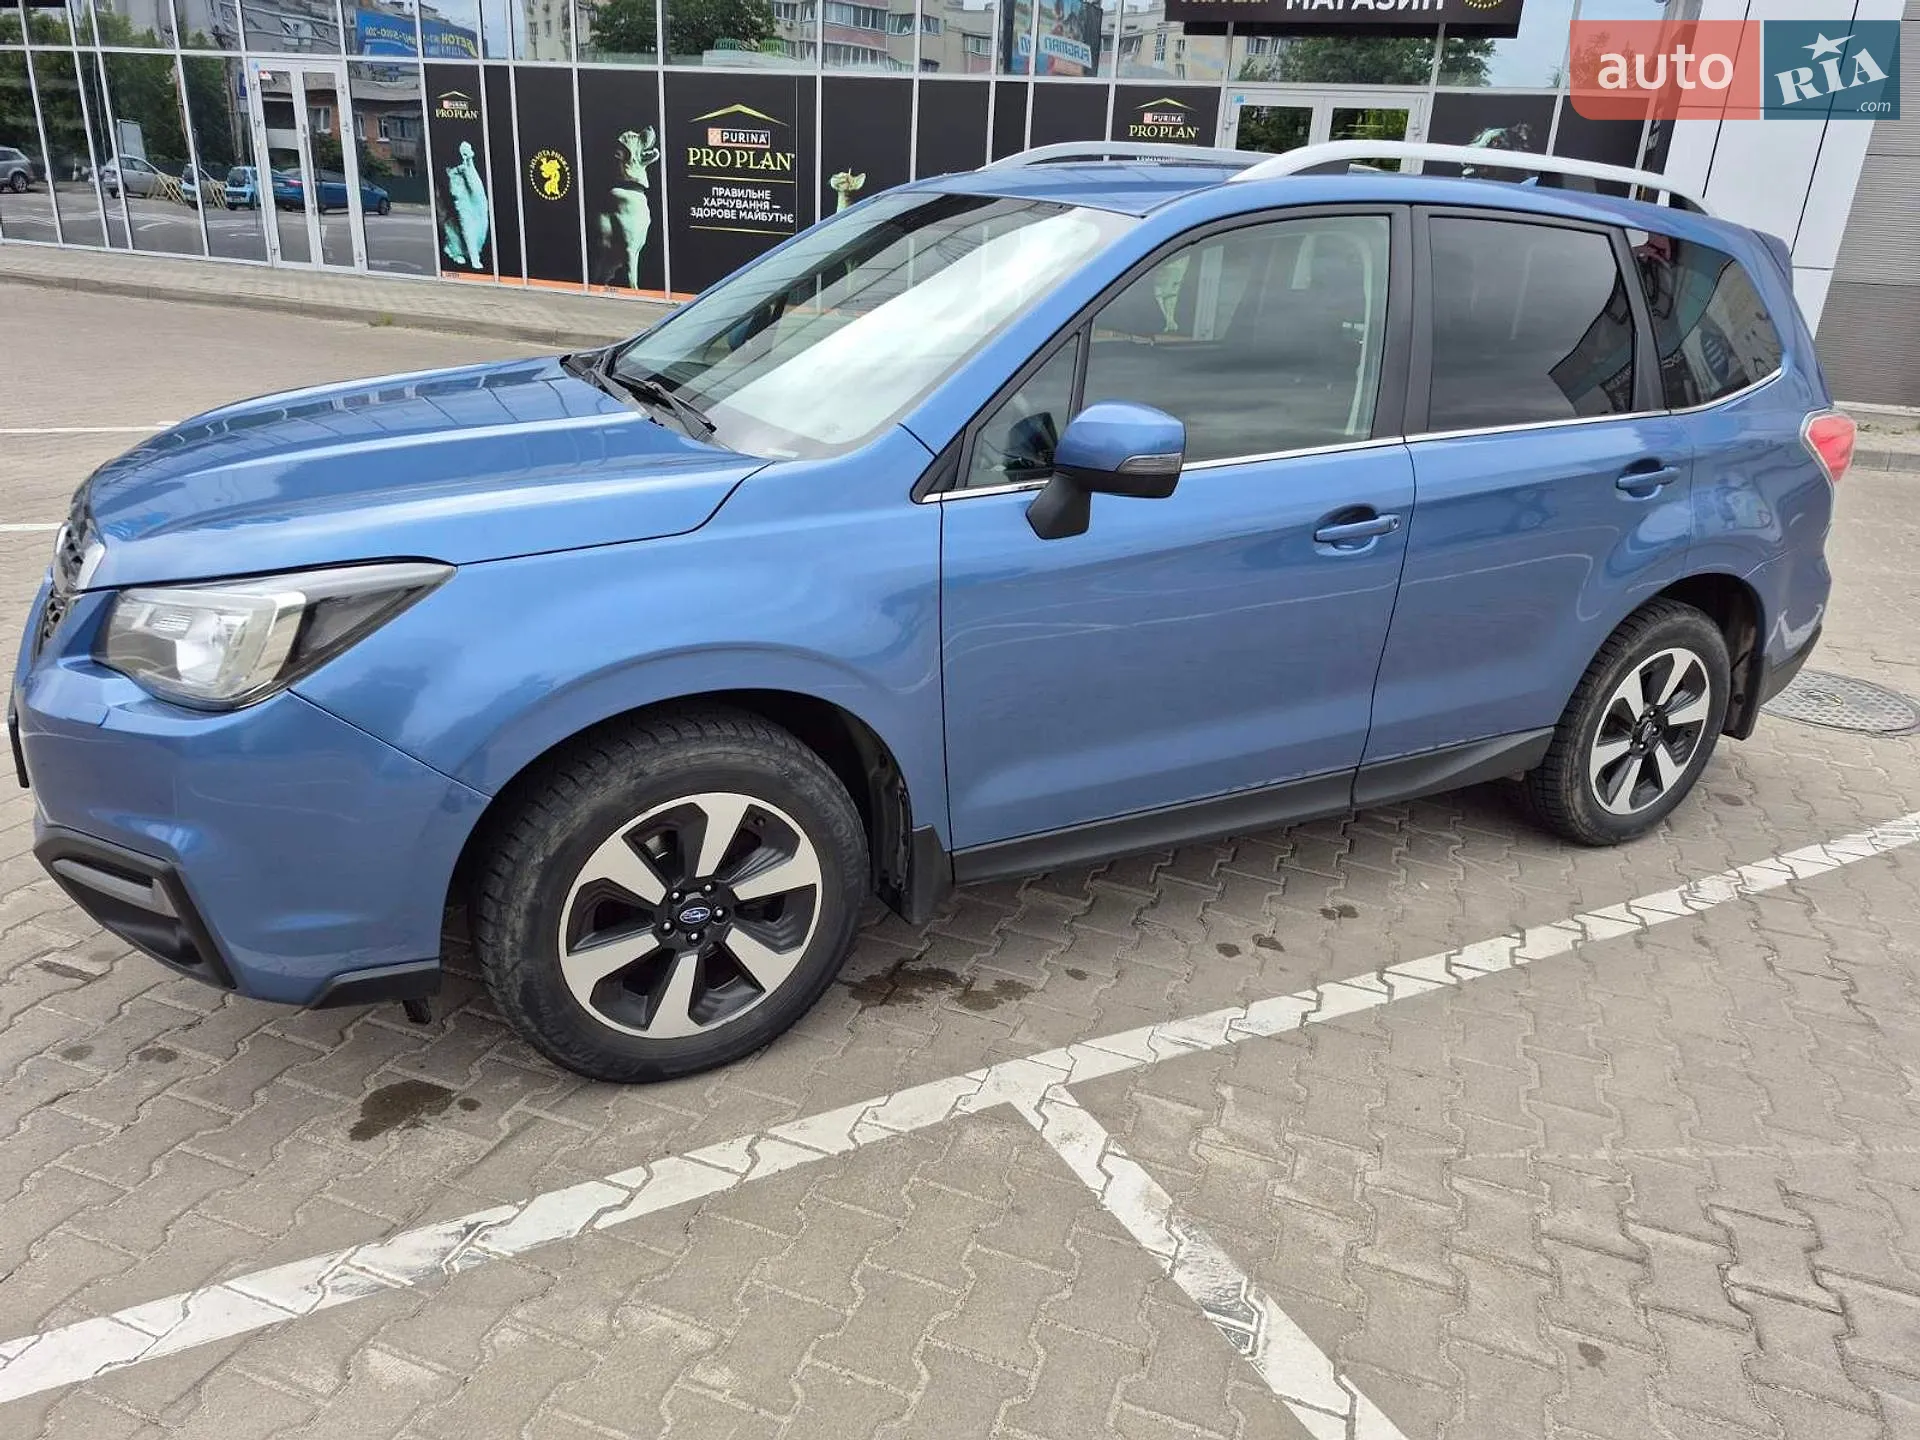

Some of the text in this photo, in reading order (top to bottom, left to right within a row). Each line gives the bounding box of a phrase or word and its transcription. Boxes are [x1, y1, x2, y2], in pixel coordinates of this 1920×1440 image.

[435, 109, 478, 120] PRO PLAN
[722, 132, 767, 144] PURINA
[1128, 125, 1196, 139] PRO PLAN
[688, 147, 793, 171] PRO PLAN
[712, 187, 772, 200] ПРАВИЛЬНЕ
[703, 197, 770, 210] ХАРЧУВАННЯ
[690, 207, 794, 224] ЗДОРОВЕ МАЙБУТНЄ
